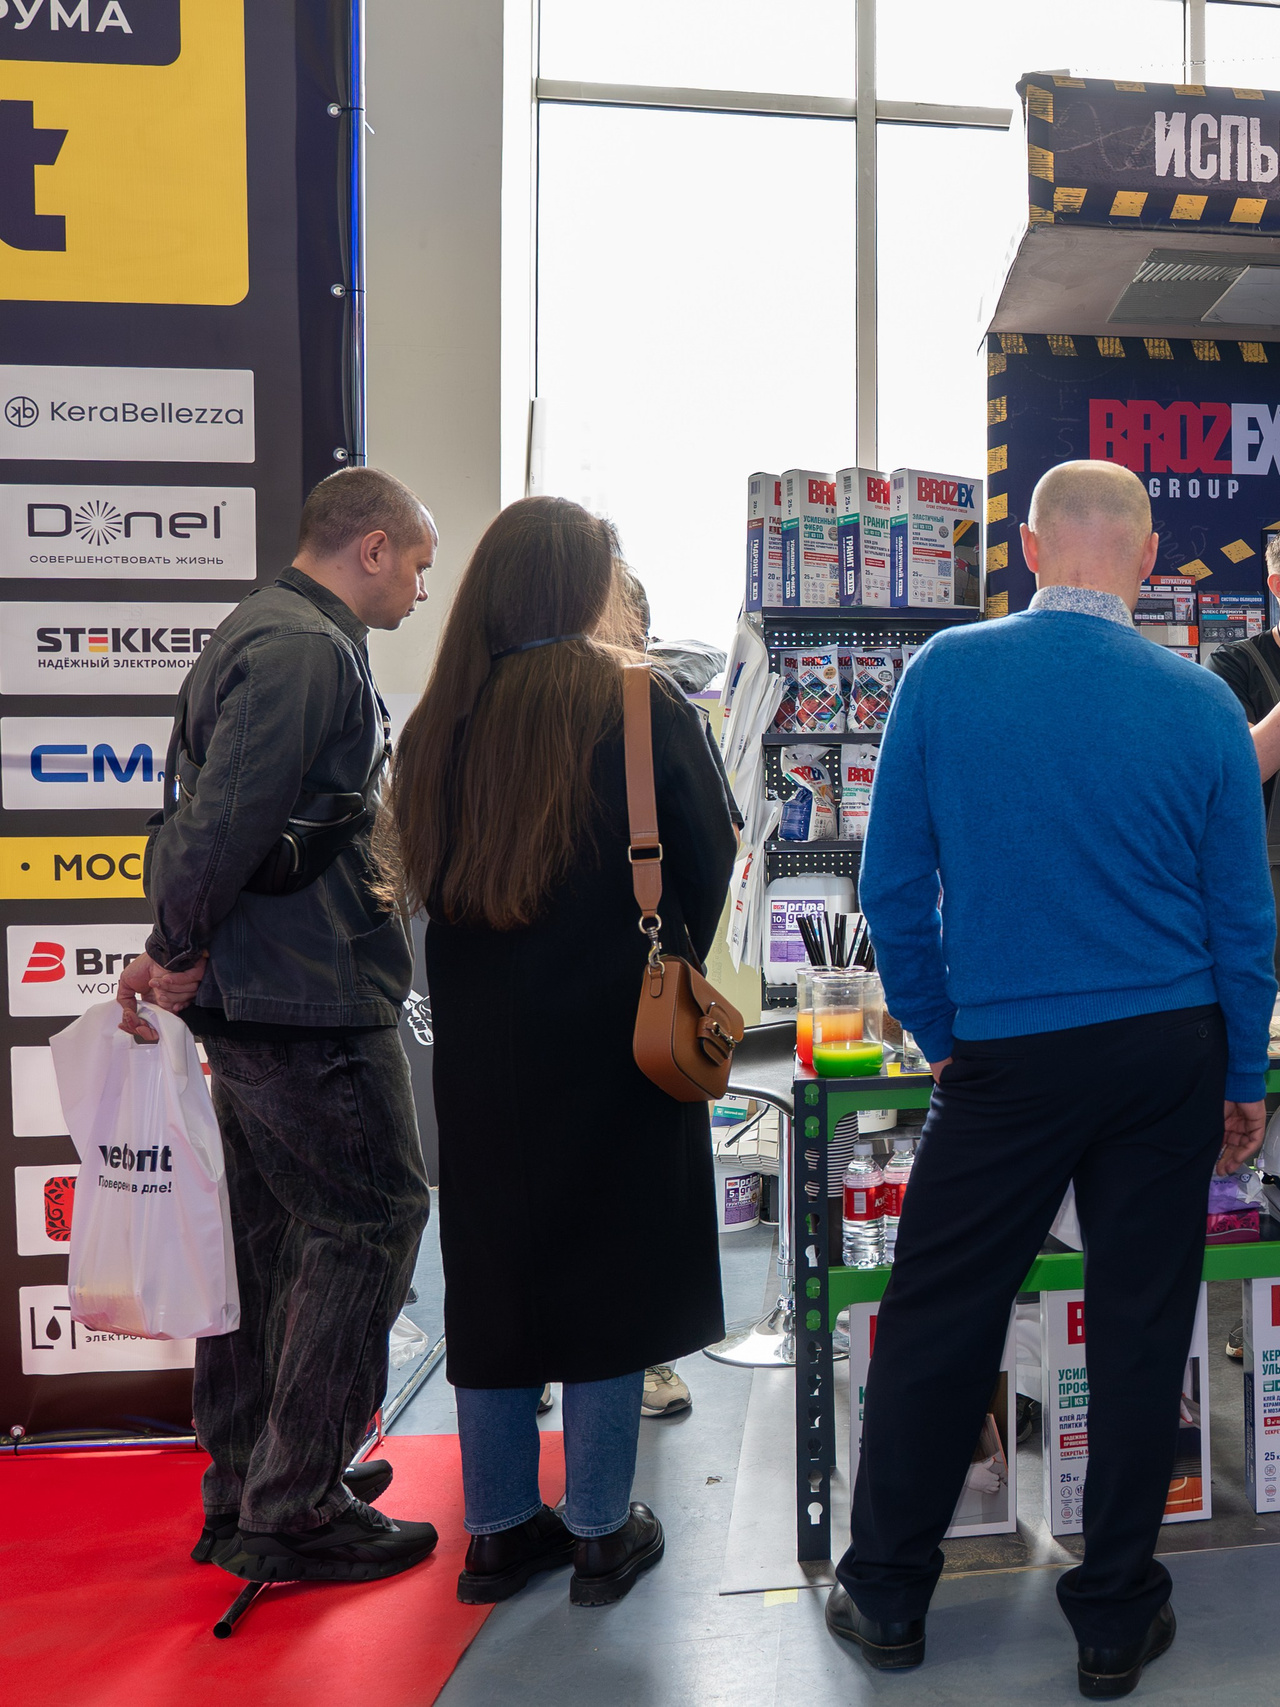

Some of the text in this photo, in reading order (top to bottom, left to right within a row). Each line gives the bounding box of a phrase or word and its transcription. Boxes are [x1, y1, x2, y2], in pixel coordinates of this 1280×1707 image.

[0, 0, 133, 34] УМА
[50, 402, 244, 425] KeraBellezza
[917, 477, 975, 509] BROZEX
[1149, 478, 1239, 499] GROUP
[804, 515, 837, 526] УСИЛЕННЫЙ
[863, 515, 890, 530] ГРАНИТ
[804, 524, 823, 532] ФИБРО
[846, 535, 854, 567] ГРАНИТ
[30, 555, 224, 566] СОВЕРШЕНСТВОВАТЬ ЖИЗНЬ
[38, 656, 110, 669] НАДЁЖНЫЙ
[801, 655, 832, 667] BROZEX
[856, 656, 887, 667] BROZEX
[788, 901, 825, 912] prima
[77, 980, 120, 994] wor
[1059, 1413, 1074, 1422] КЛЕЙ
[1059, 1422, 1082, 1430] ПЛИТКИ
[1060, 1450, 1084, 1458] СЕКРЕТЫ
[1264, 1452, 1275, 1461] 25
[1060, 1473, 1072, 1483] 25
